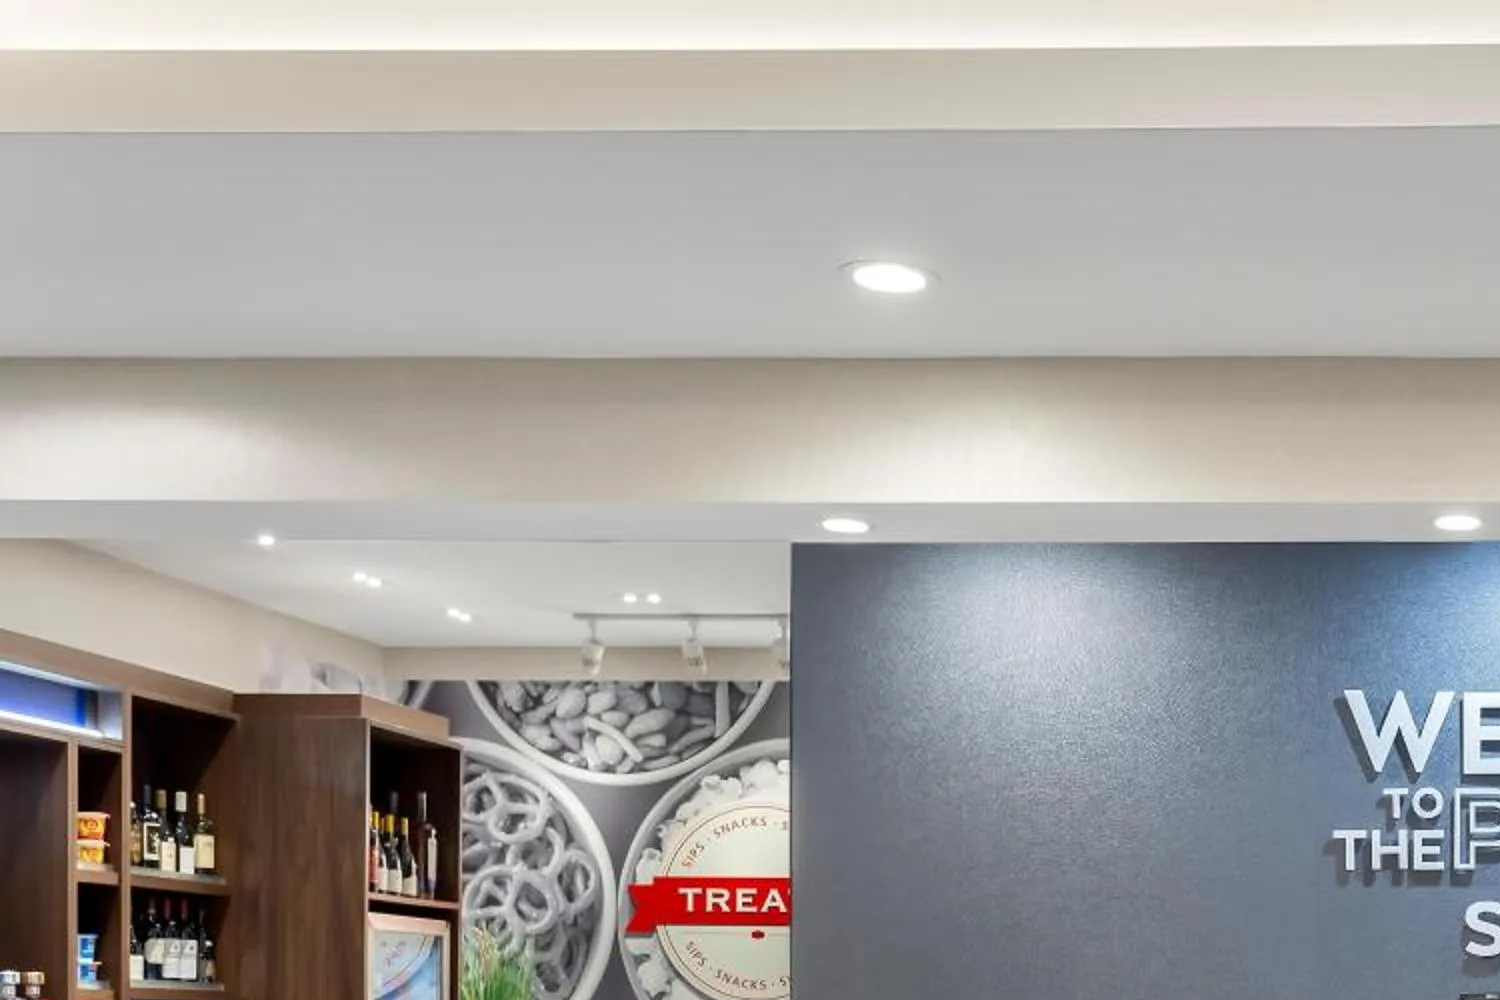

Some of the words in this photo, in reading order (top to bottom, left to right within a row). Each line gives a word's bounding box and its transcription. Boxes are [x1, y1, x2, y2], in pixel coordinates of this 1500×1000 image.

[1383, 787, 1444, 819] TO
[681, 840, 705, 868] SIPS
[713, 815, 767, 839] SNACKS
[1333, 829, 1445, 871] THE
[677, 887, 790, 913] TREA
[686, 941, 708, 967] SIPS
[715, 968, 767, 990] SNACKS
